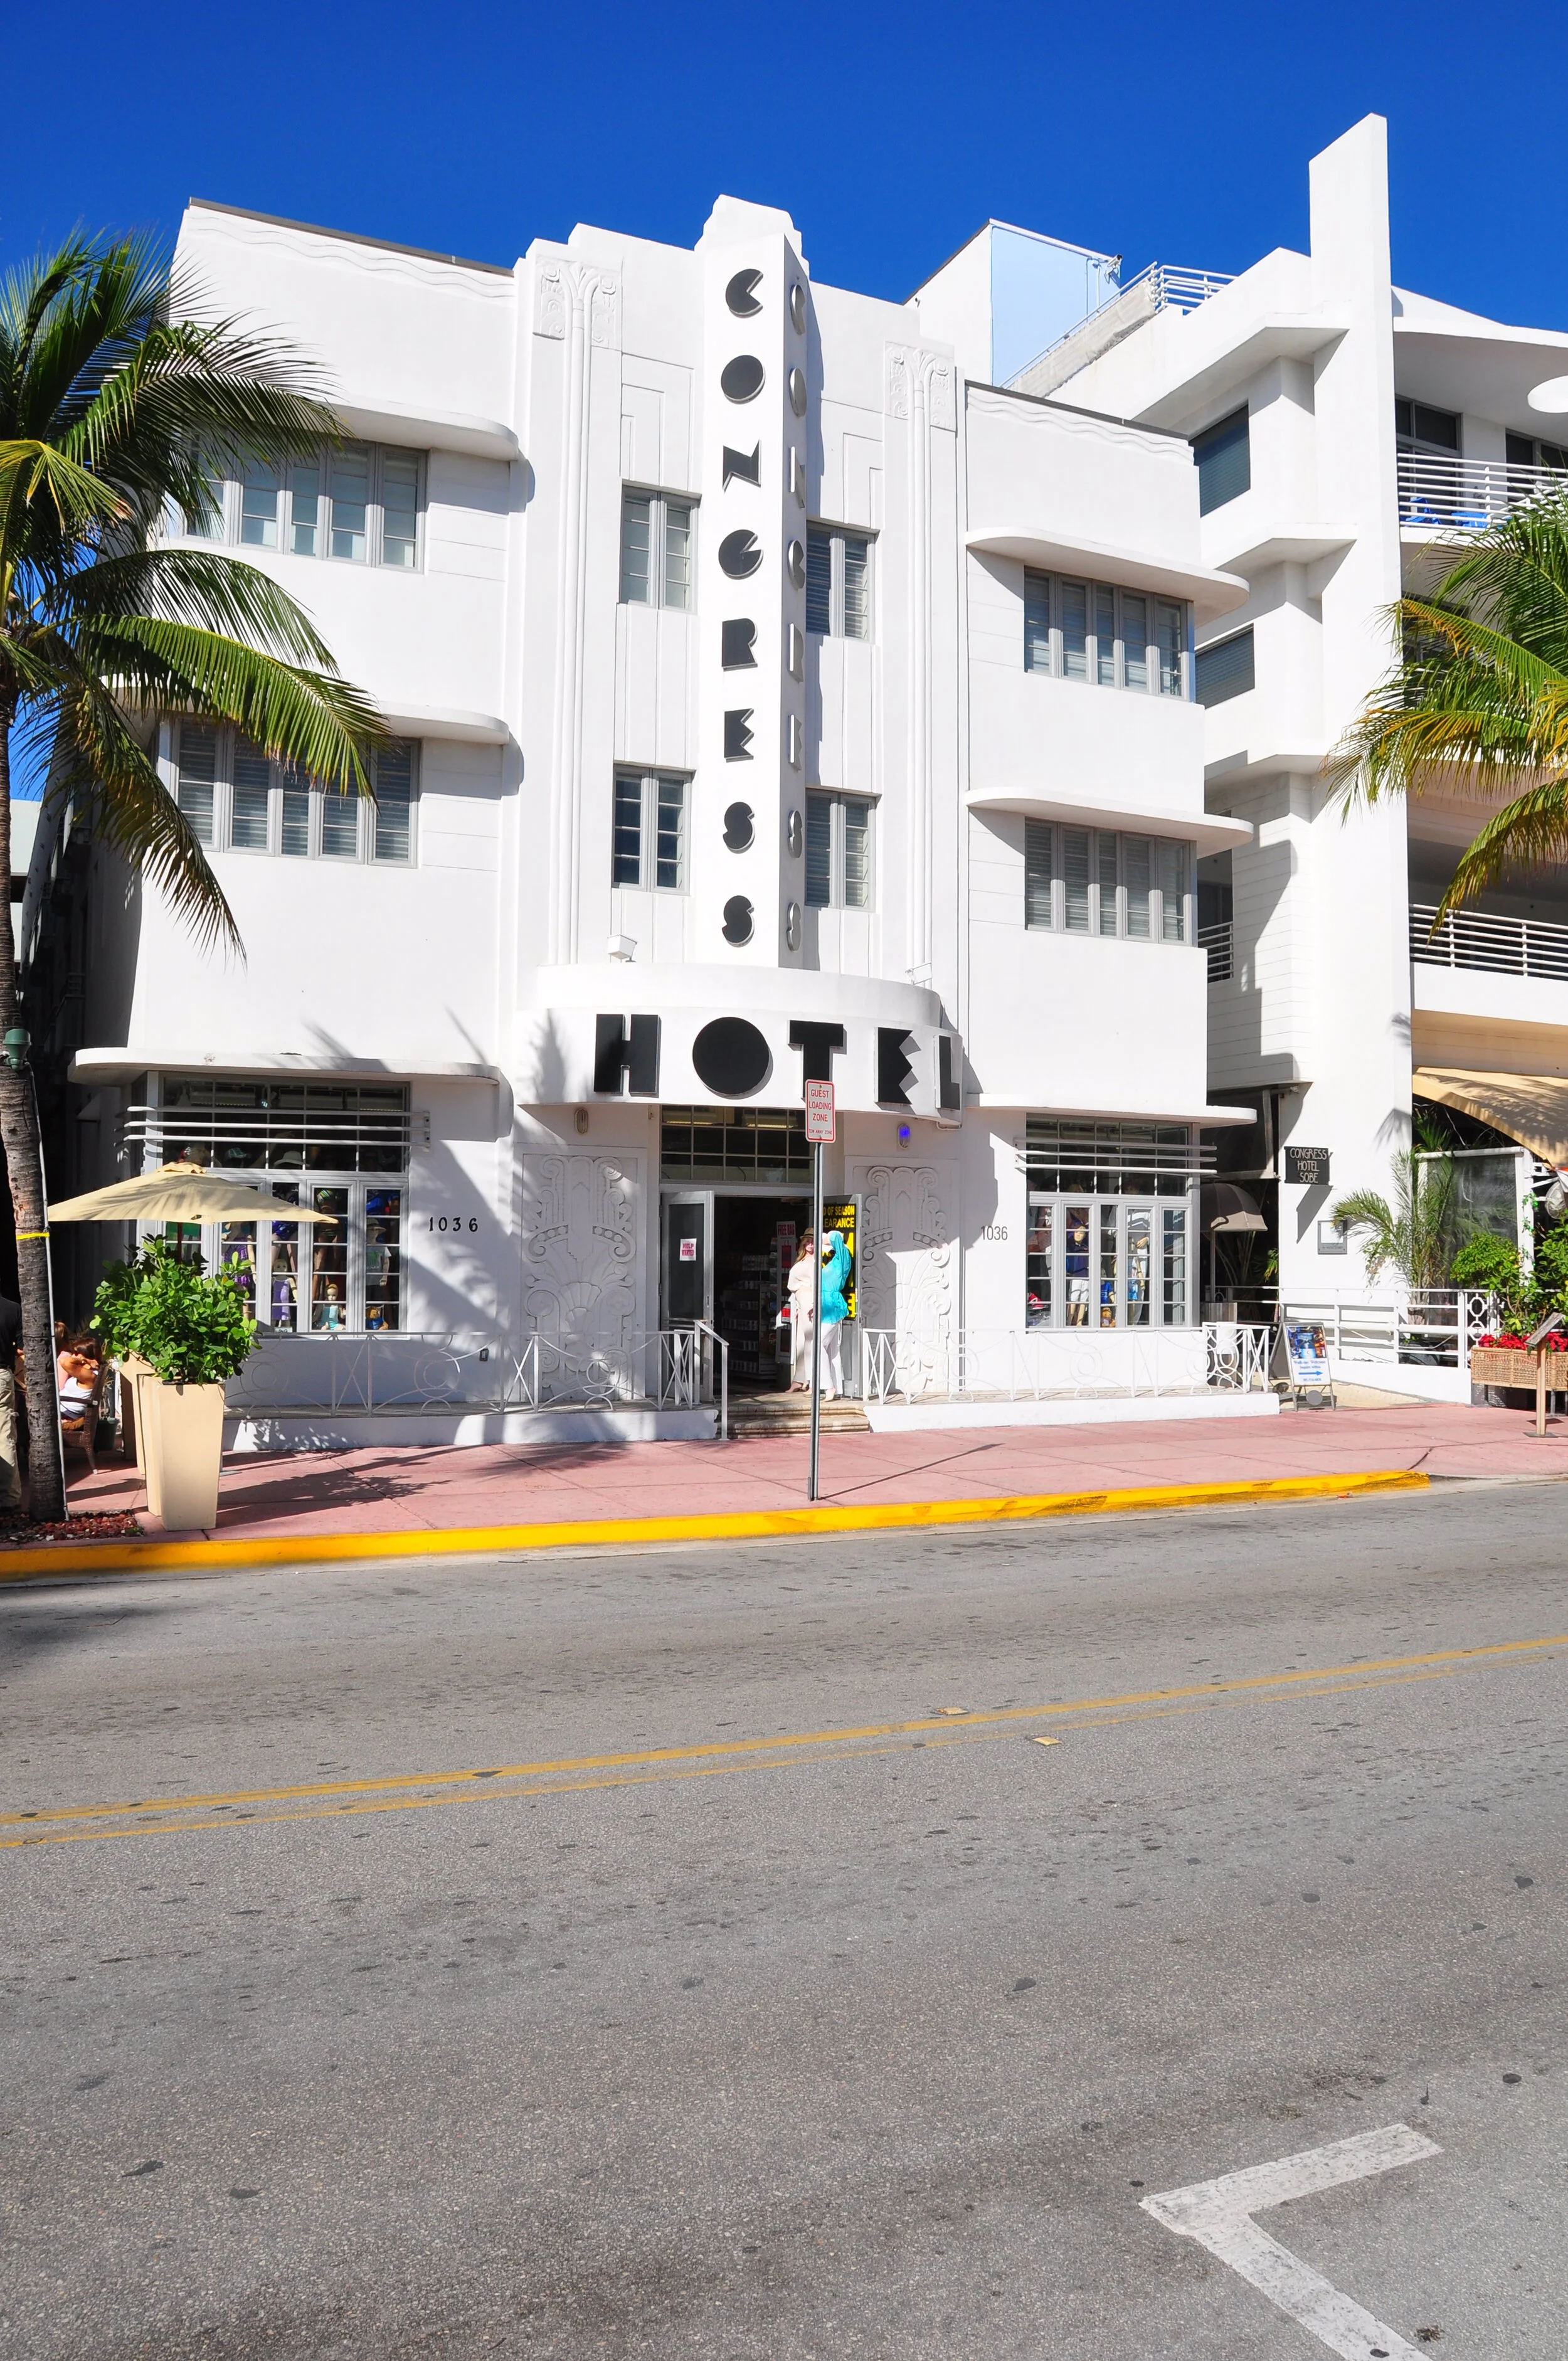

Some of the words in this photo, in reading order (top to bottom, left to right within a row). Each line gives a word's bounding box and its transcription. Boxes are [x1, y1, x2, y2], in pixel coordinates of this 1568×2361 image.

[718, 268, 766, 948] CONGRESS
[593, 1013, 962, 1111] HOTEL
[810, 1089, 829, 1098] GUEST
[808, 1101, 832, 1110] LOADING
[812, 1113, 828, 1122] ZONE
[1290, 1148, 1327, 1160] CONGRESS
[1297, 1160, 1320, 1172] HOTEL
[1299, 1172, 1319, 1184] SOBE
[827, 1206, 834, 1216] OF
[835, 1205, 855, 1216] SEASON
[428, 1216, 479, 1233] 1036
[824, 1218, 855, 1228] EARANCE
[980, 1225, 1008, 1241] 1036
